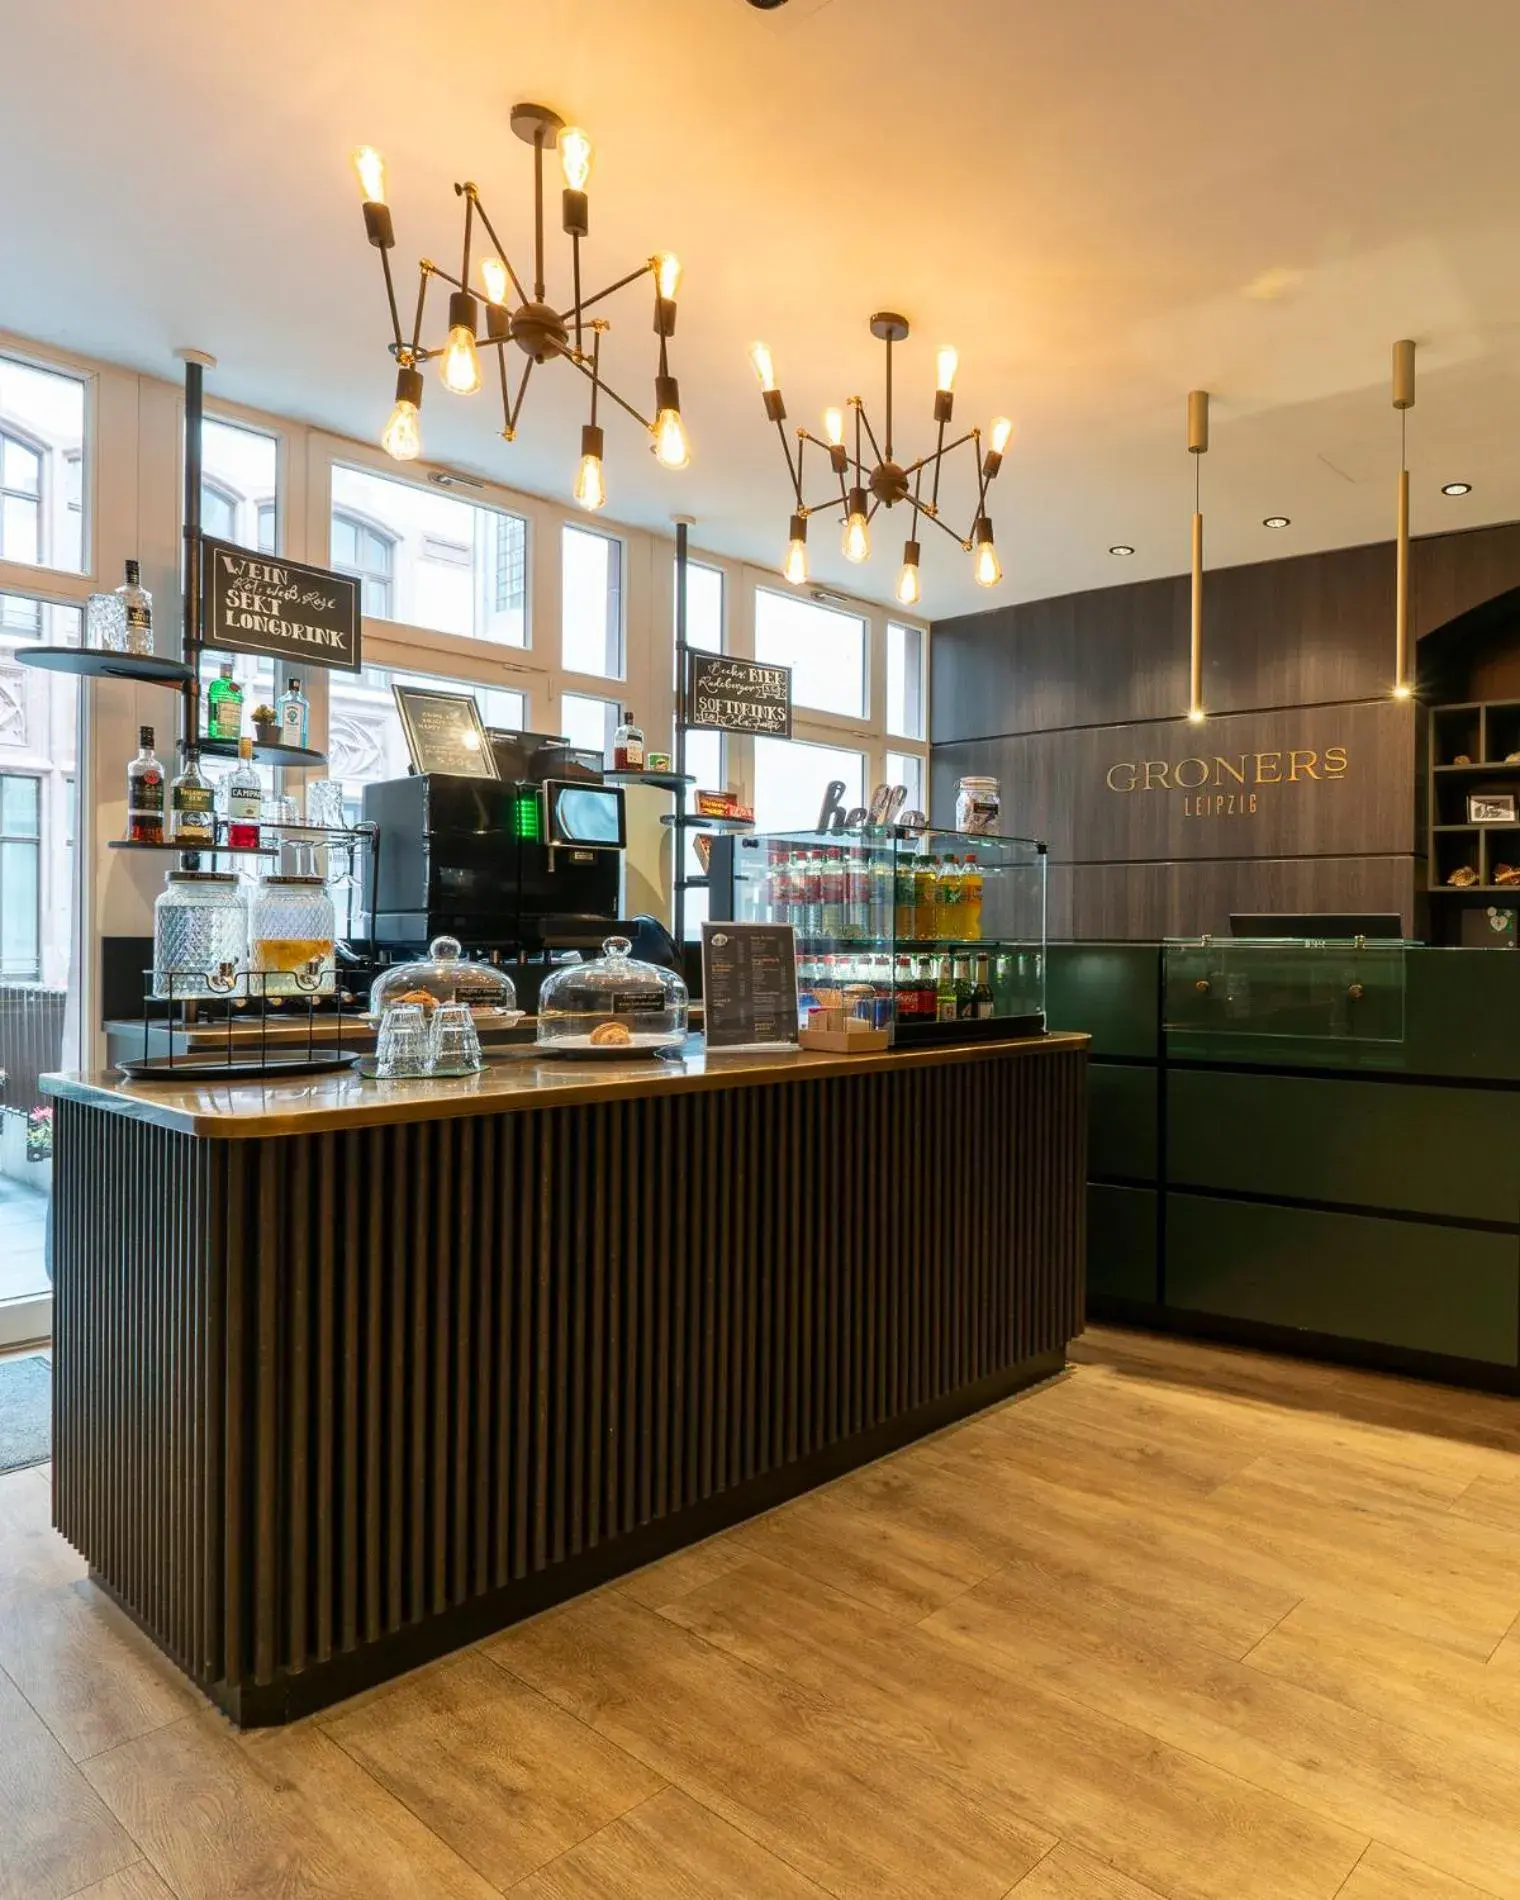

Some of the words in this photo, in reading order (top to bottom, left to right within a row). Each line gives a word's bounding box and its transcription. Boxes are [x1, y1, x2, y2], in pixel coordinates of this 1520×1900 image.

[222, 556, 288, 585] WEIN
[226, 589, 282, 616] SEKT
[226, 610, 347, 649] LONGDRINK
[749, 668, 784, 685] BIER
[699, 696, 785, 721] SOFTDRINKS
[1106, 747, 1347, 792] GRONERS
[816, 780, 927, 838] hello
[1184, 794, 1257, 817] LEIPZIG
